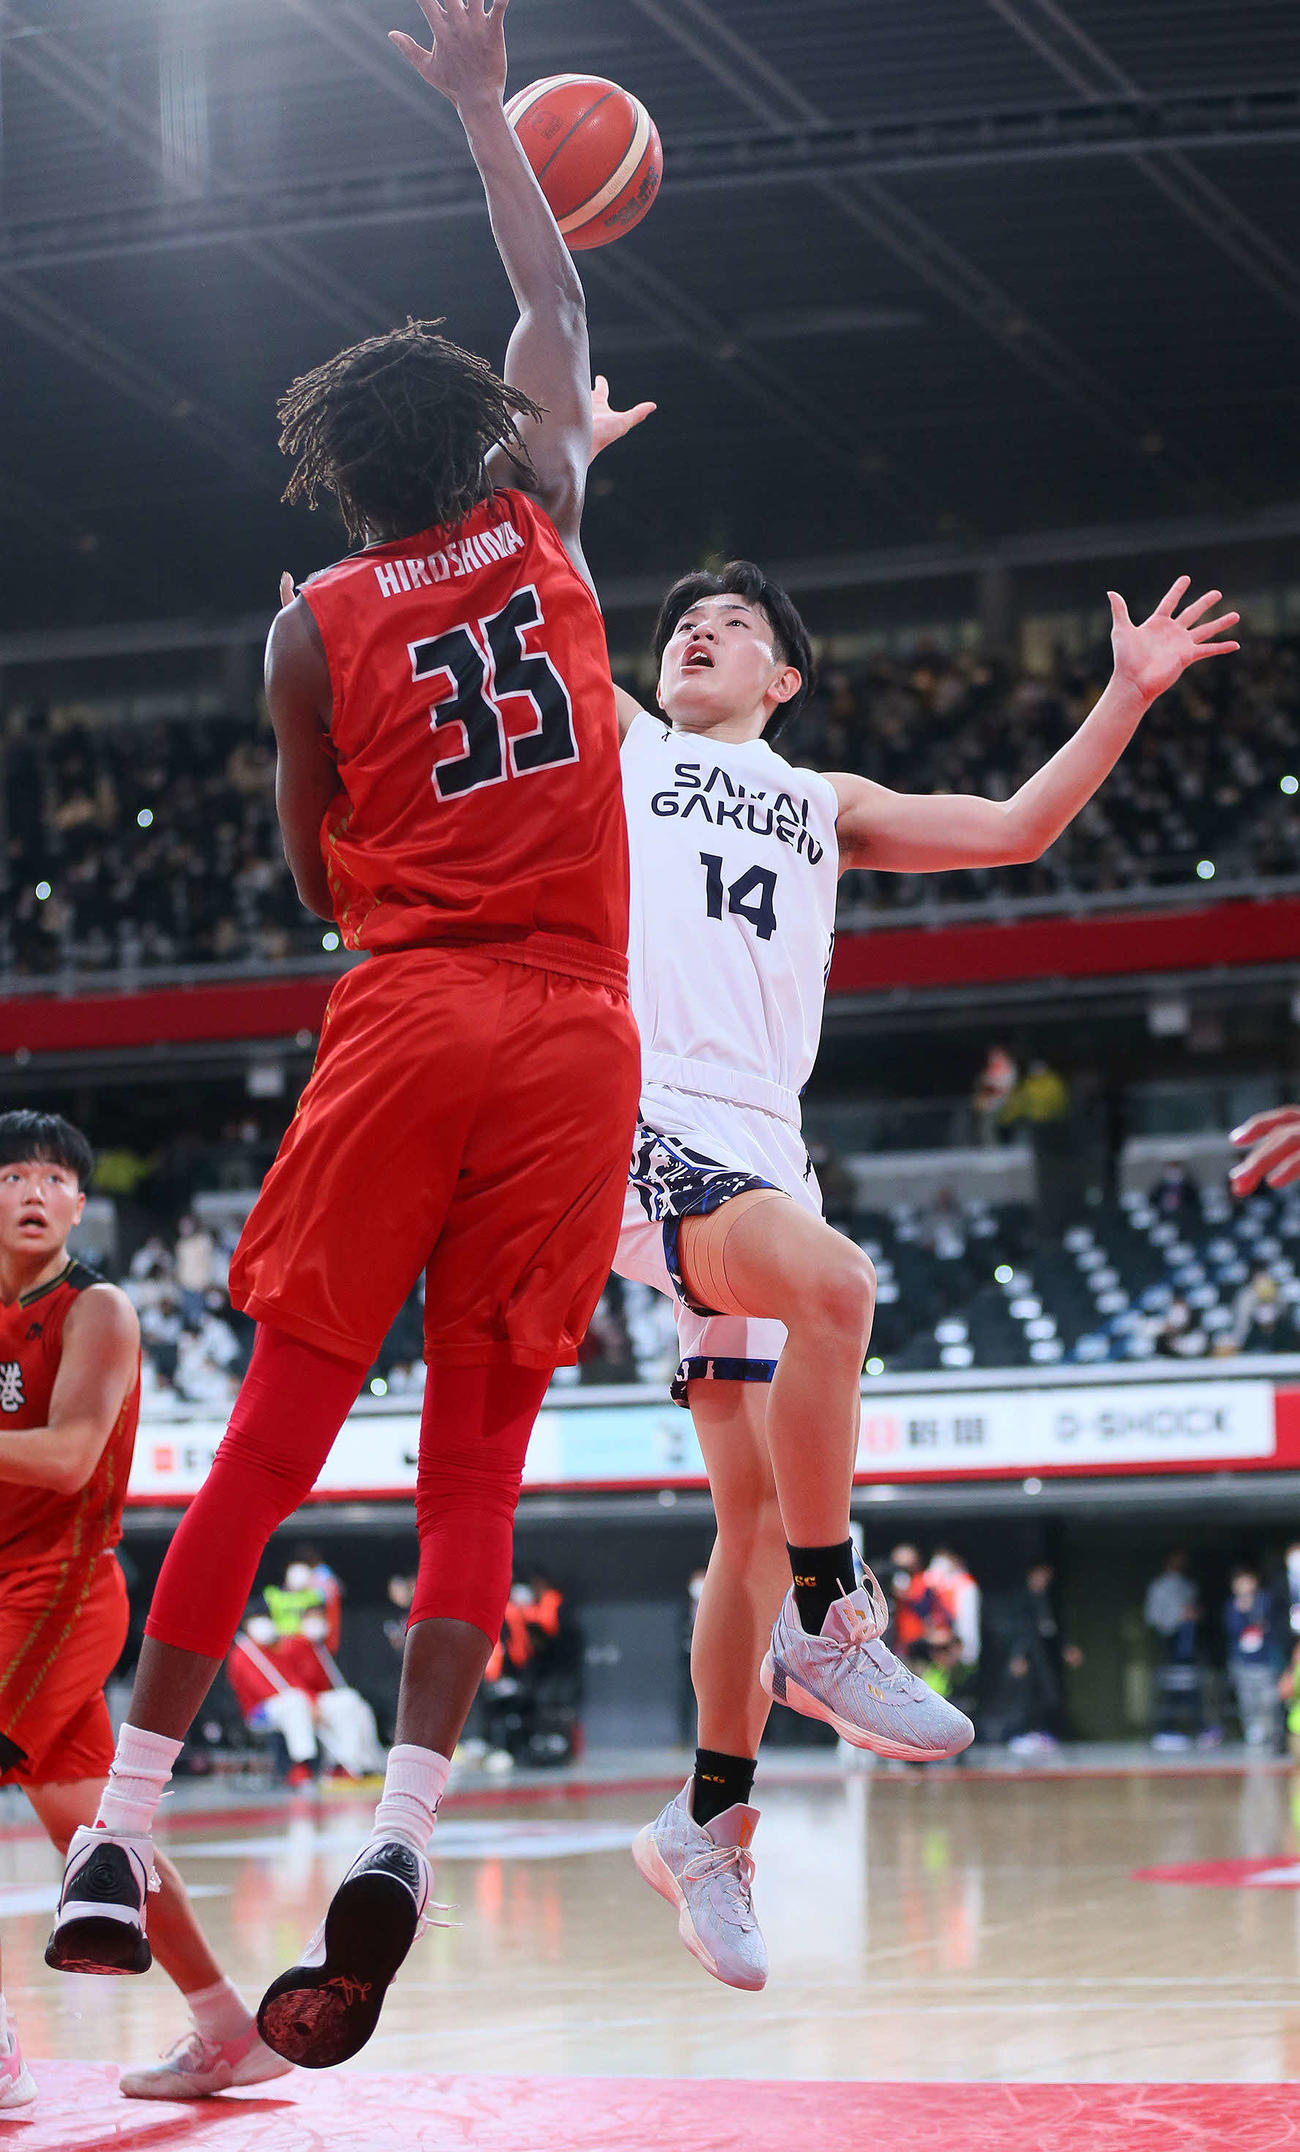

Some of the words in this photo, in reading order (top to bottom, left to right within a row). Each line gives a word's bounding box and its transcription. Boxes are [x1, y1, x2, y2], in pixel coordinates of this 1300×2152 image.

[374, 521, 525, 598] HIROSHIMA
[407, 584, 580, 803] 35
[651, 791, 824, 865] GAKUEN
[699, 851, 777, 941] 14
